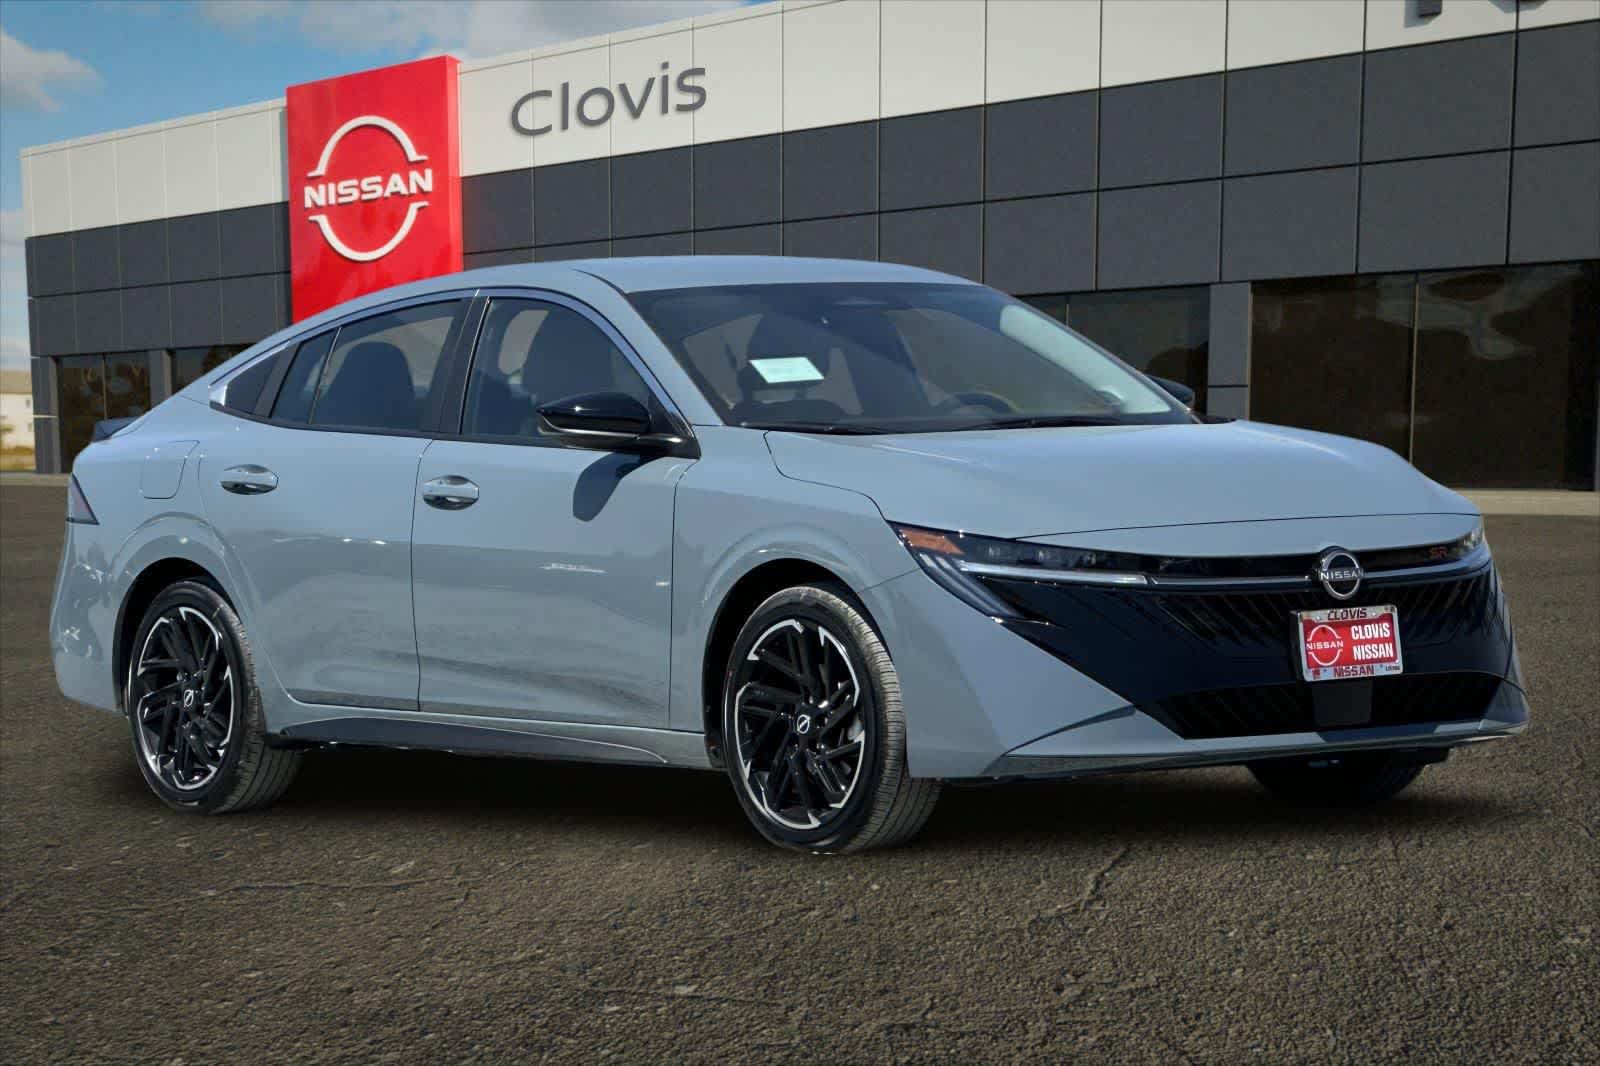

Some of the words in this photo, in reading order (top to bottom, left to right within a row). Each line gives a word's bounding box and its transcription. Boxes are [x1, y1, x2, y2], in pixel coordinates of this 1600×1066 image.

[511, 62, 707, 136] Clovis
[304, 168, 433, 208] NISSAN
[1320, 568, 1363, 580] NISSAN
[1327, 608, 1367, 620] CLOVIS
[1306, 640, 1344, 650] NISSAN
[1353, 643, 1394, 661] NISSAN
[1333, 665, 1375, 677] NISSAN
